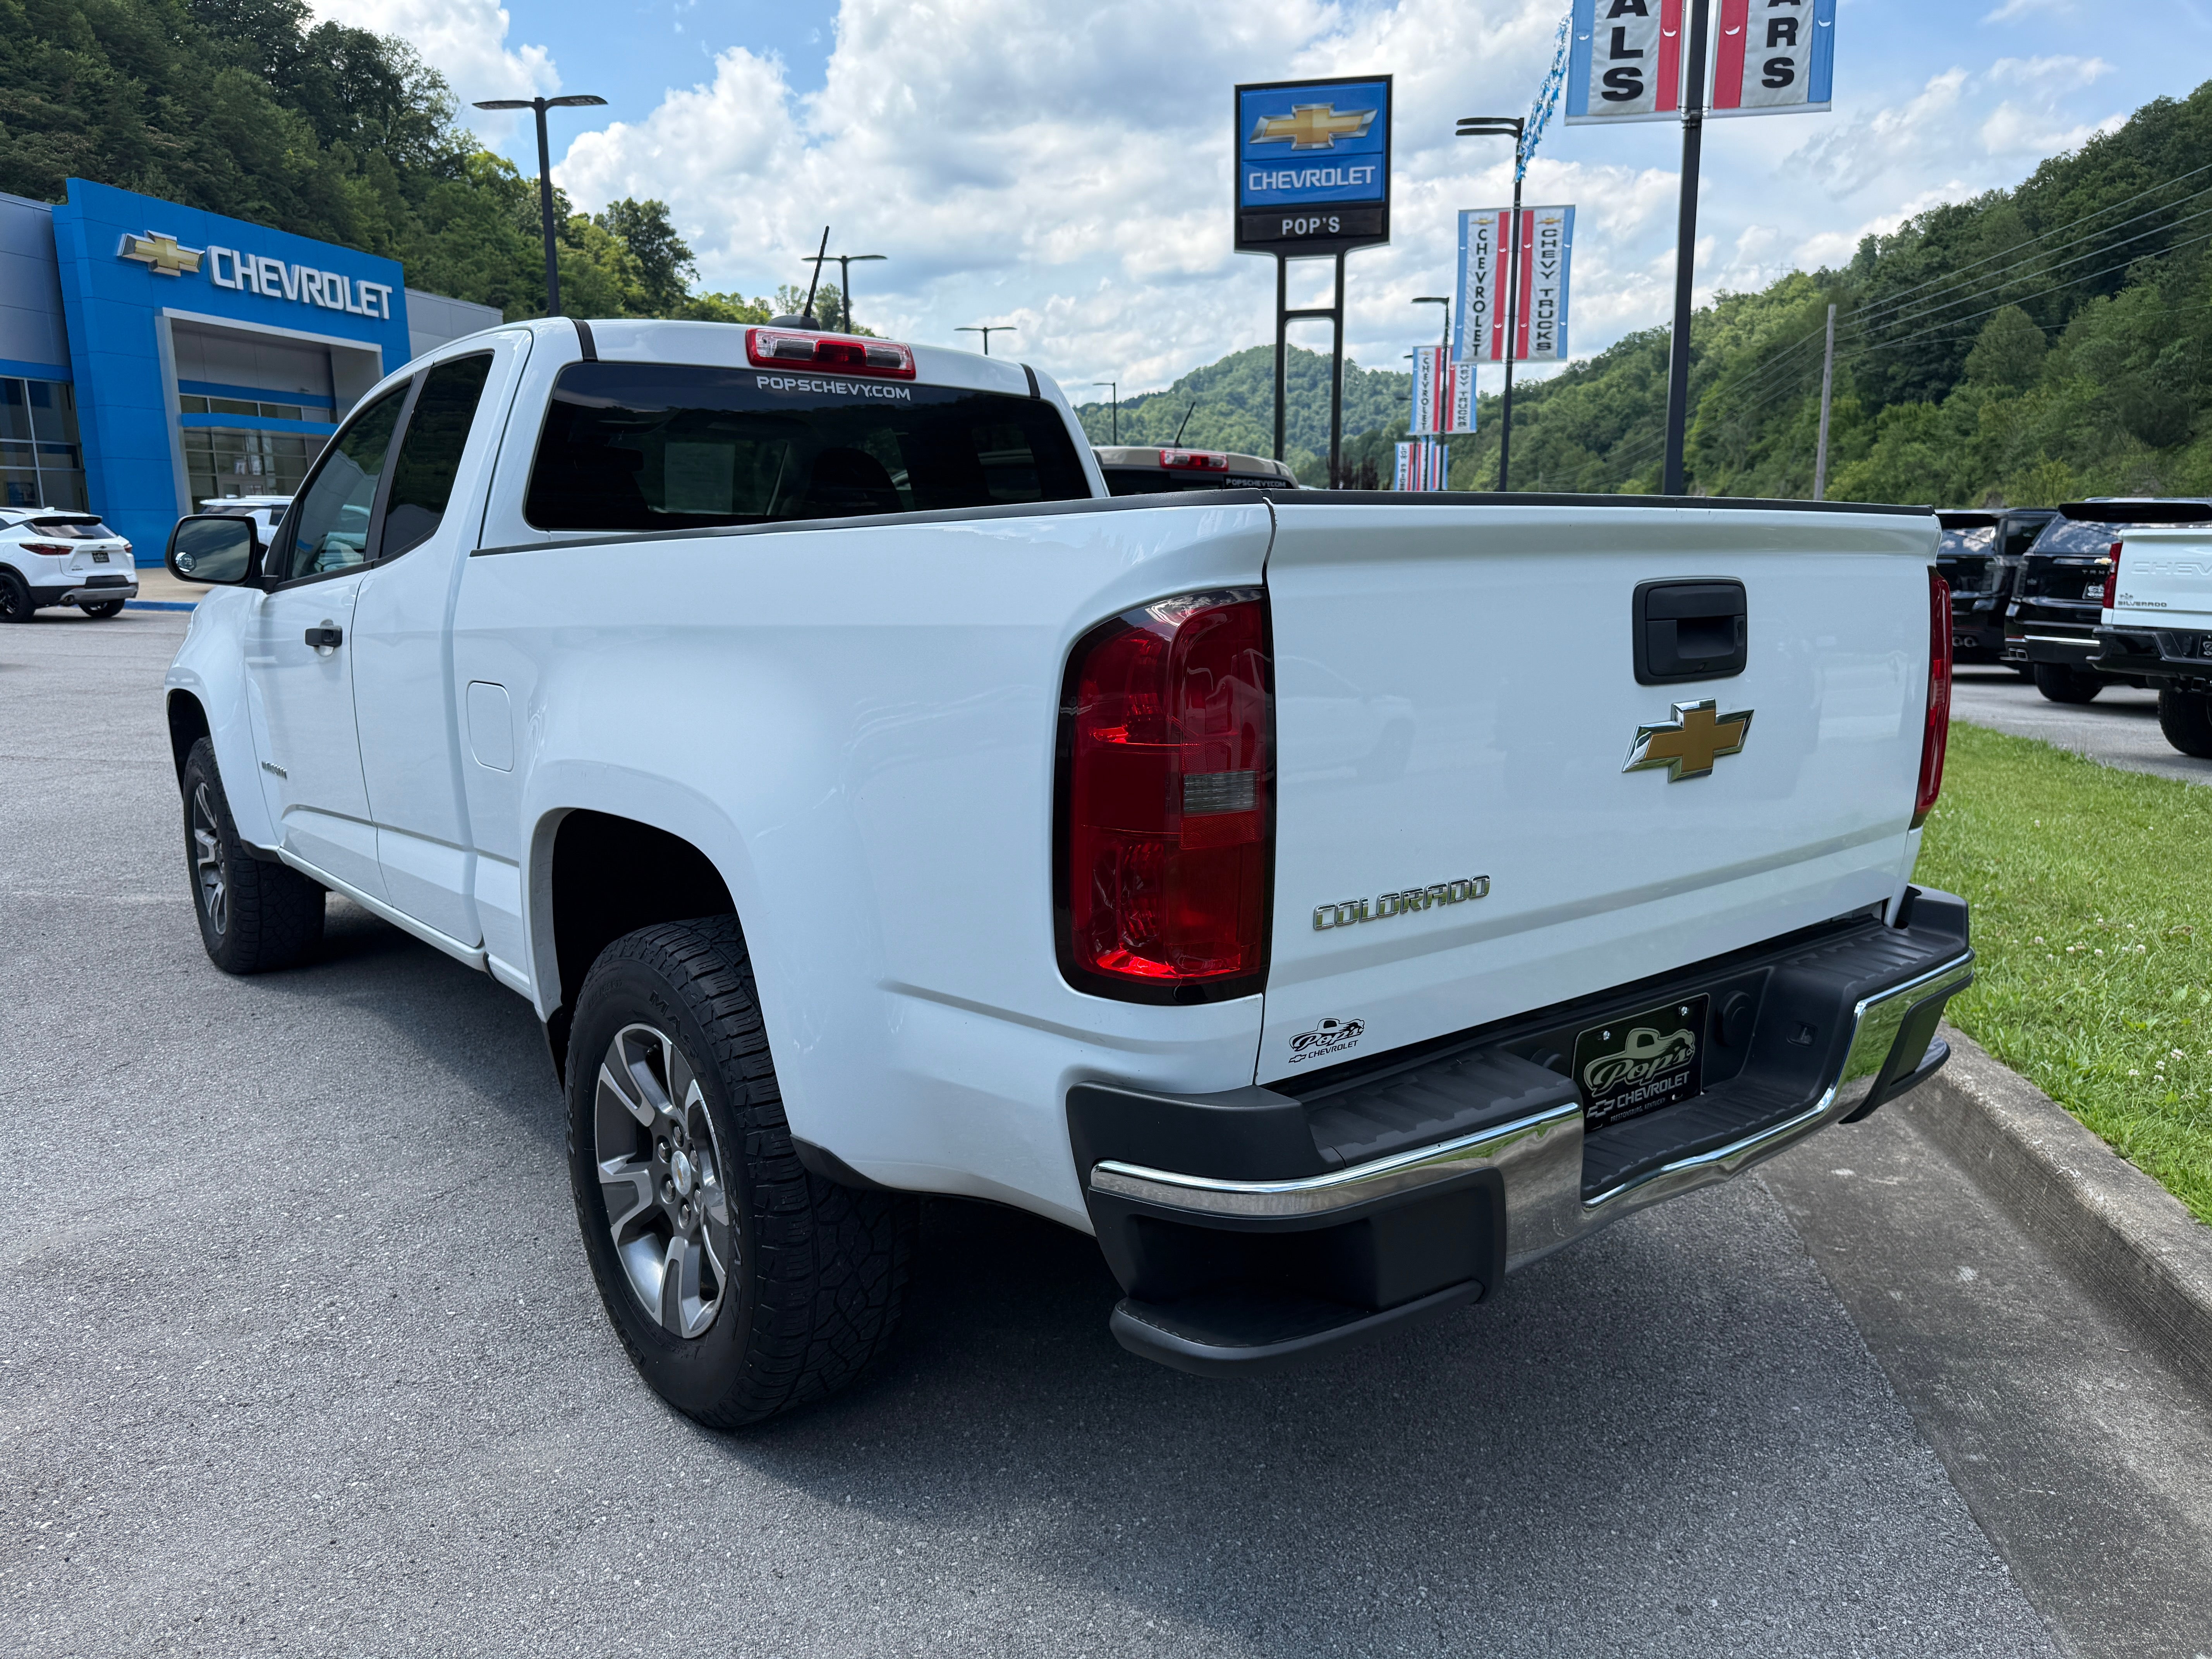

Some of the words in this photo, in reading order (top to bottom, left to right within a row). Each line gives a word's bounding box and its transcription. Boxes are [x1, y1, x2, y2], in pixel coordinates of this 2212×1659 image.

[1248, 165, 1376, 191] CHEVROLET
[1281, 216, 1340, 235] POP'S
[1540, 229, 1558, 279] CHEVY
[207, 245, 393, 319] CHEVROLET
[1472, 229, 1487, 356] CHEVROLET
[1536, 288, 1554, 351] TRUCKS
[756, 376, 911, 401] POPSCHEVY.COM
[1421, 357, 1430, 430] CHEVROLET
[1313, 874, 1490, 930] COLORADO
[1309, 1040, 1358, 1058] CHEVROLET
[1593, 1047, 1688, 1091] Pop's
[1617, 1071, 1690, 1108] CHEVROLET
[1644, 1097, 1666, 1109] KENTUCKY
